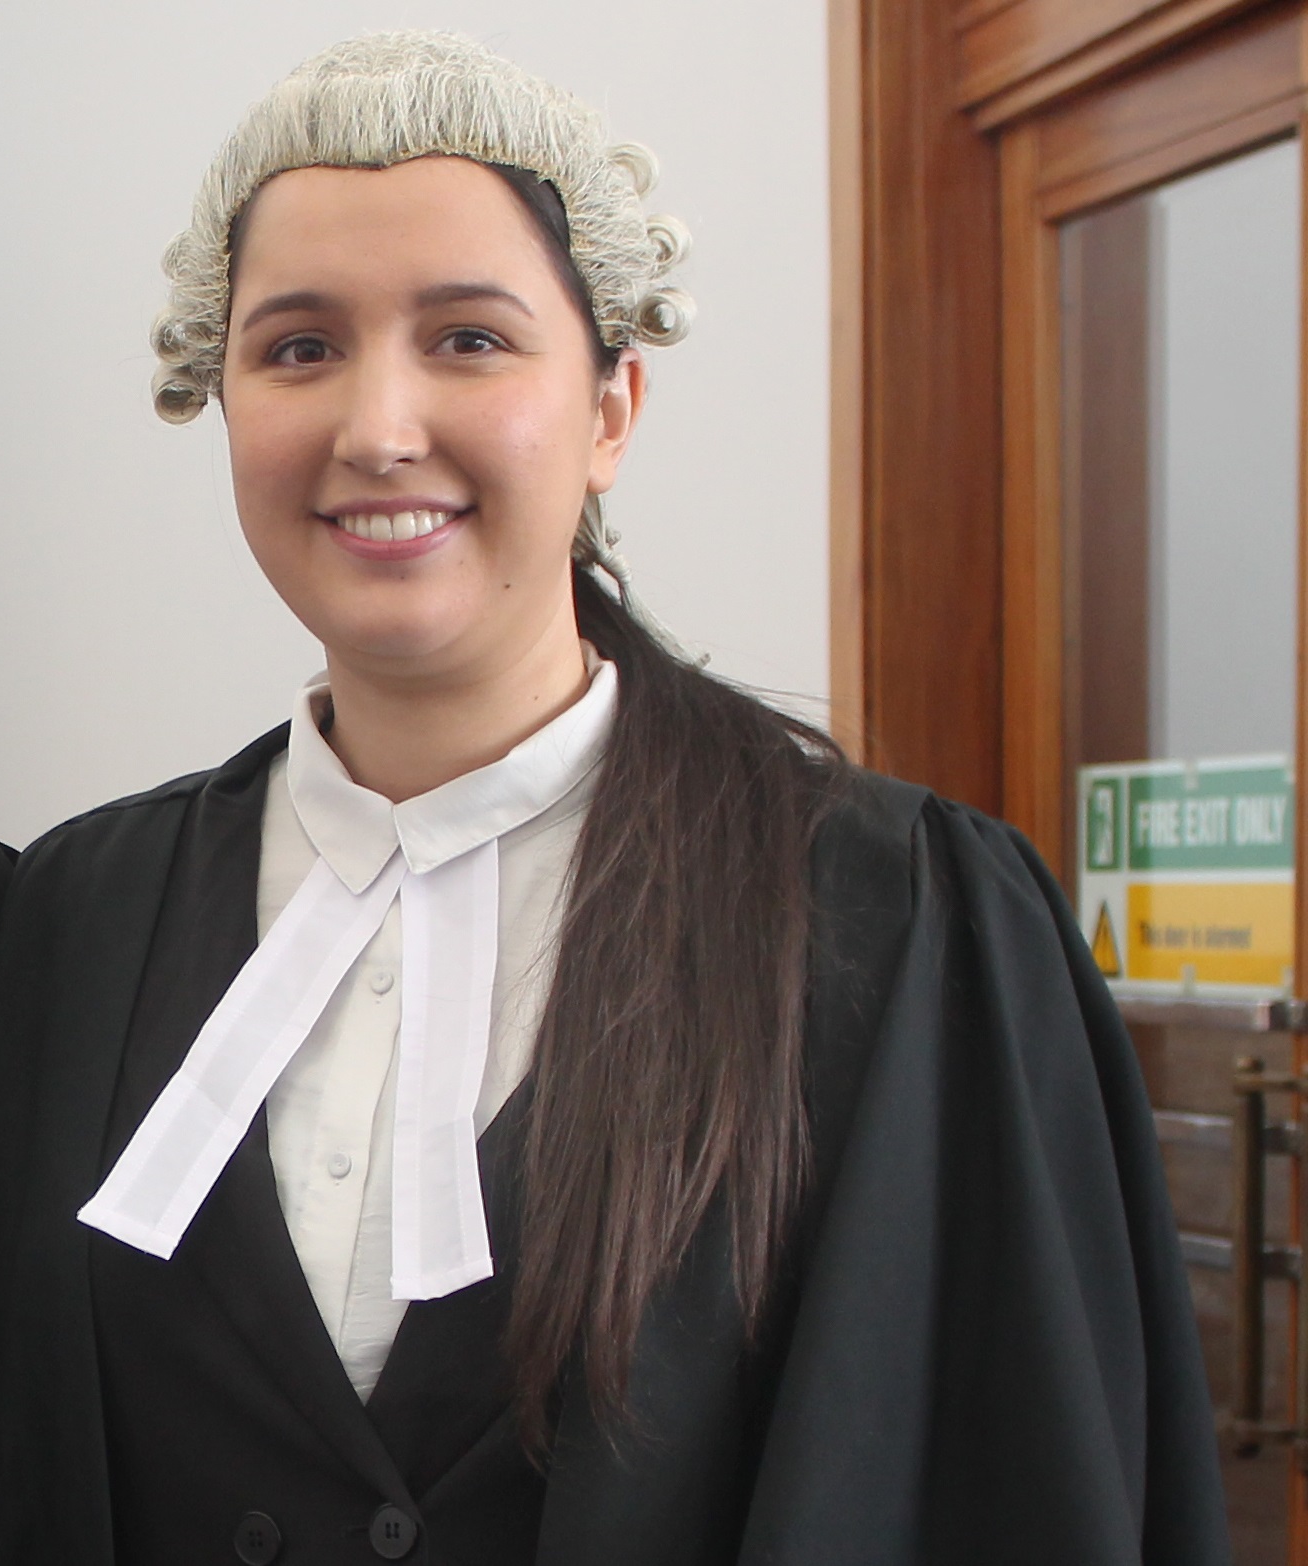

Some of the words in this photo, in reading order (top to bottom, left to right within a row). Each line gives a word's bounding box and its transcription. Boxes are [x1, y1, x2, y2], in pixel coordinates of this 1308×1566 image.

[1138, 801, 1180, 847] FIRE
[1184, 799, 1230, 846] EXIT
[1235, 796, 1288, 845] ONLY
